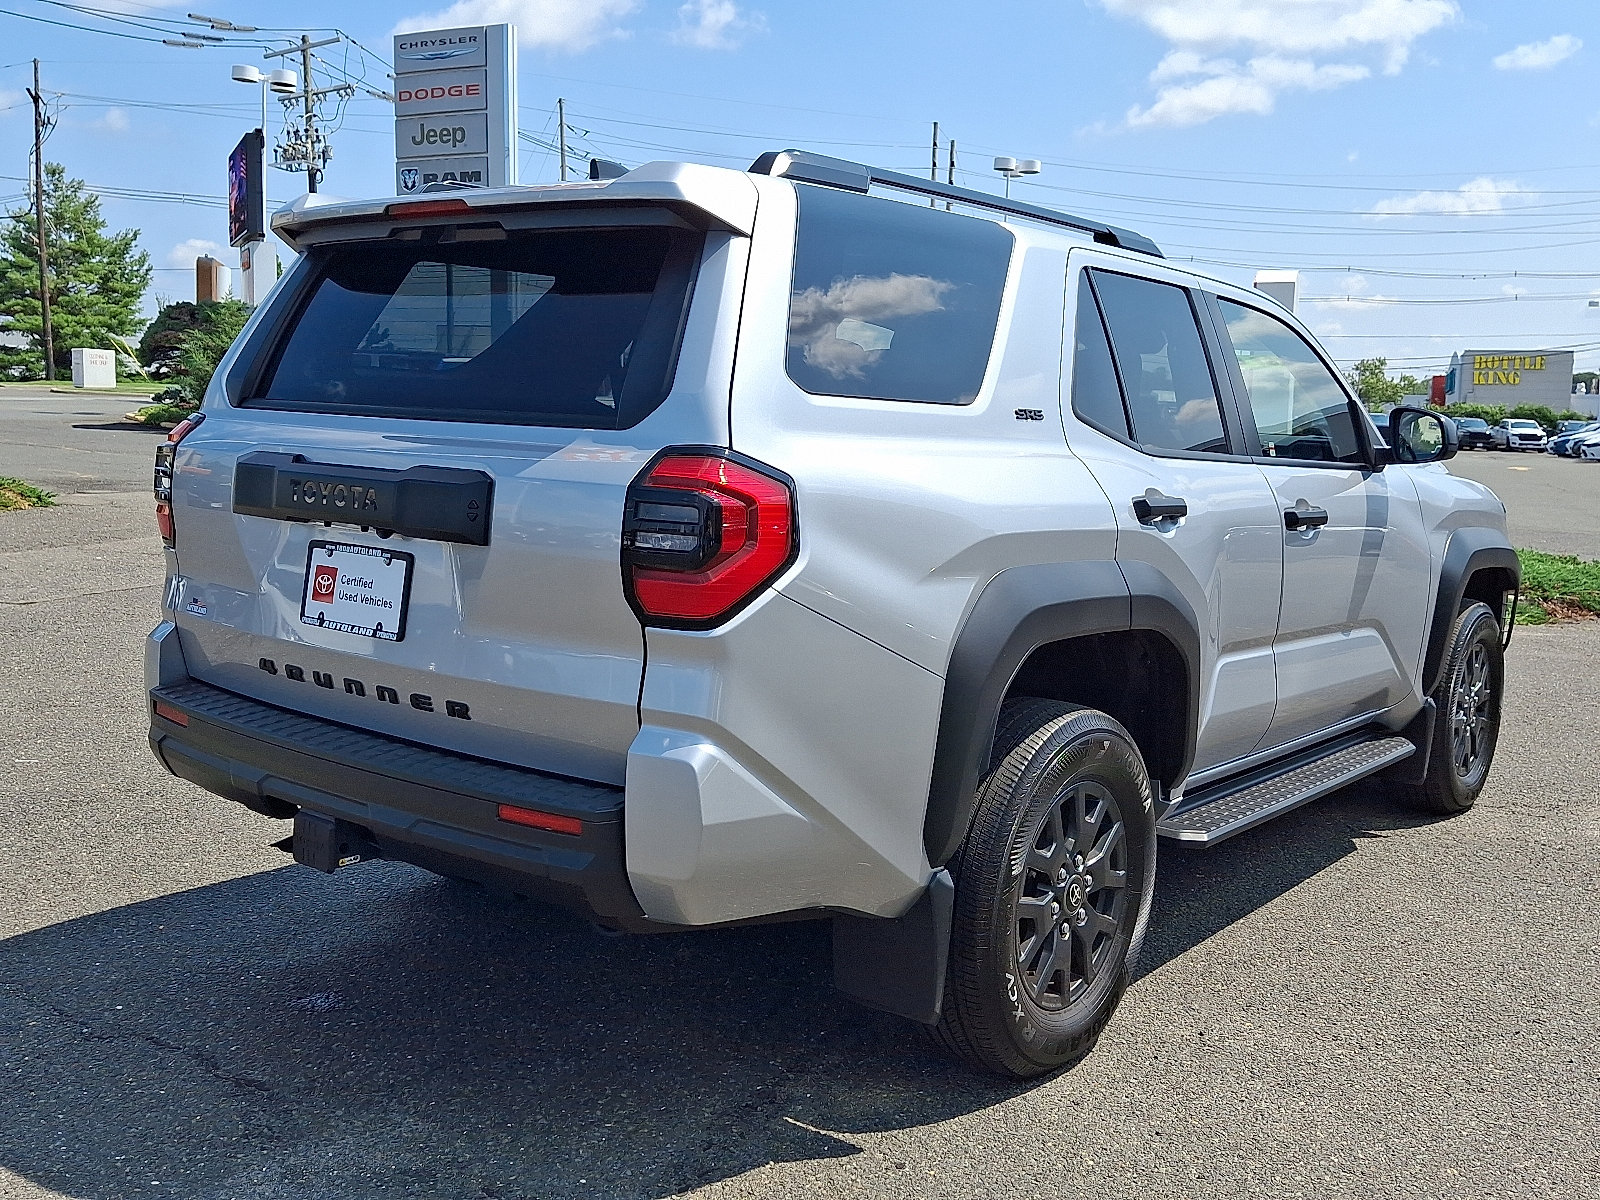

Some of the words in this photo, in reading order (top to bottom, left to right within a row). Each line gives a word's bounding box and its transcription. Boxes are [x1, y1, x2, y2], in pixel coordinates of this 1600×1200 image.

[400, 35, 478, 50] CHRYSLER
[399, 84, 480, 102] DODGE
[411, 123, 466, 148] Jeep
[423, 171, 482, 183] RAM
[1473, 355, 1547, 370] BOTTLE
[1473, 371, 1521, 385] KING
[290, 479, 378, 512] TOYOTA
[341, 574, 374, 589] Certified
[338, 590, 358, 603] Used
[360, 593, 393, 609] Vehicles
[323, 620, 374, 637] AUTOLAND
[258, 657, 472, 721] 4RUNNER
